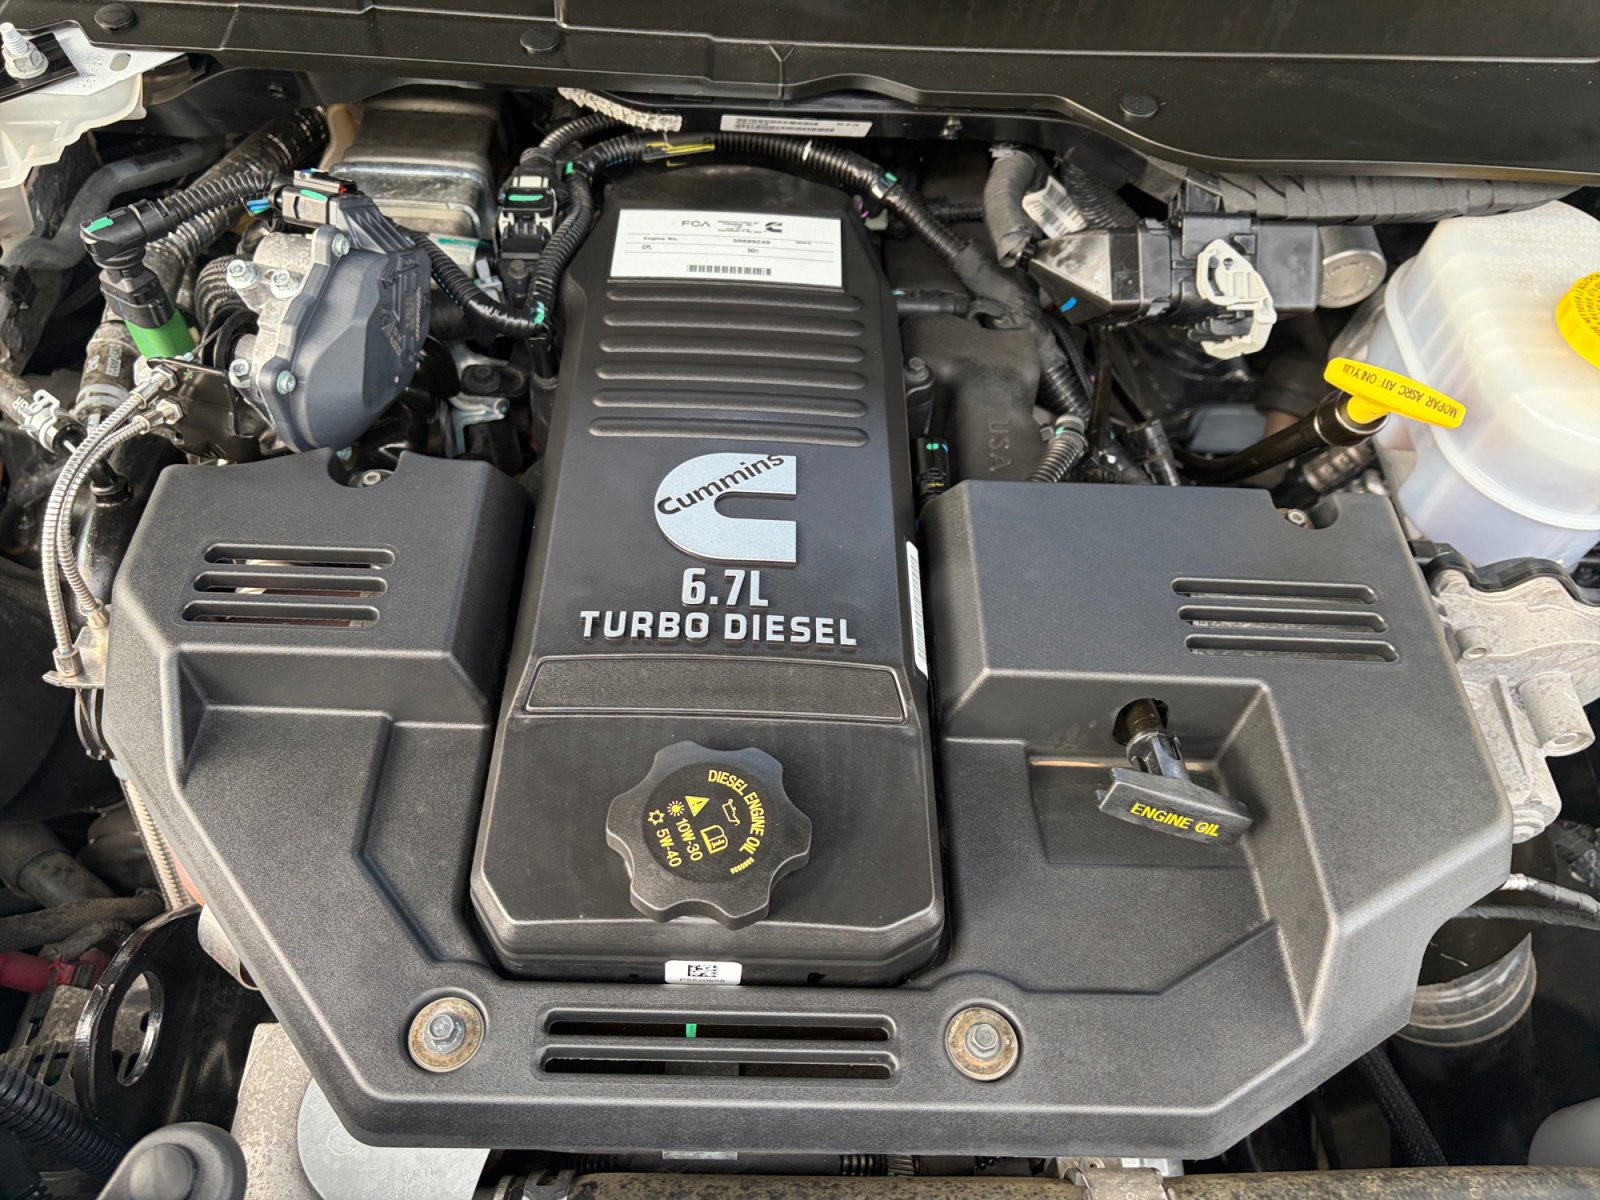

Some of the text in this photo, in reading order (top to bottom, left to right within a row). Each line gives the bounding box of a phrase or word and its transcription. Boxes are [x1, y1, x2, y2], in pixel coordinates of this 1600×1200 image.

[681, 220, 711, 228] FCA
[1397, 384, 1425, 403] ASRC
[1425, 396, 1459, 419] MOPAR
[988, 420, 1011, 472] USA
[657, 454, 784, 515] Cummins
[682, 567, 769, 607] 6.7L
[580, 610, 858, 646] TURBO DIESEL
[708, 769, 748, 796] DIESEL
[743, 791, 766, 837] ENGINE
[1130, 802, 1220, 837] ENGINE OIL
[656, 827, 682, 868] 5W-40
[676, 817, 703, 862] 10W-30
[739, 837, 761, 855] OIL
